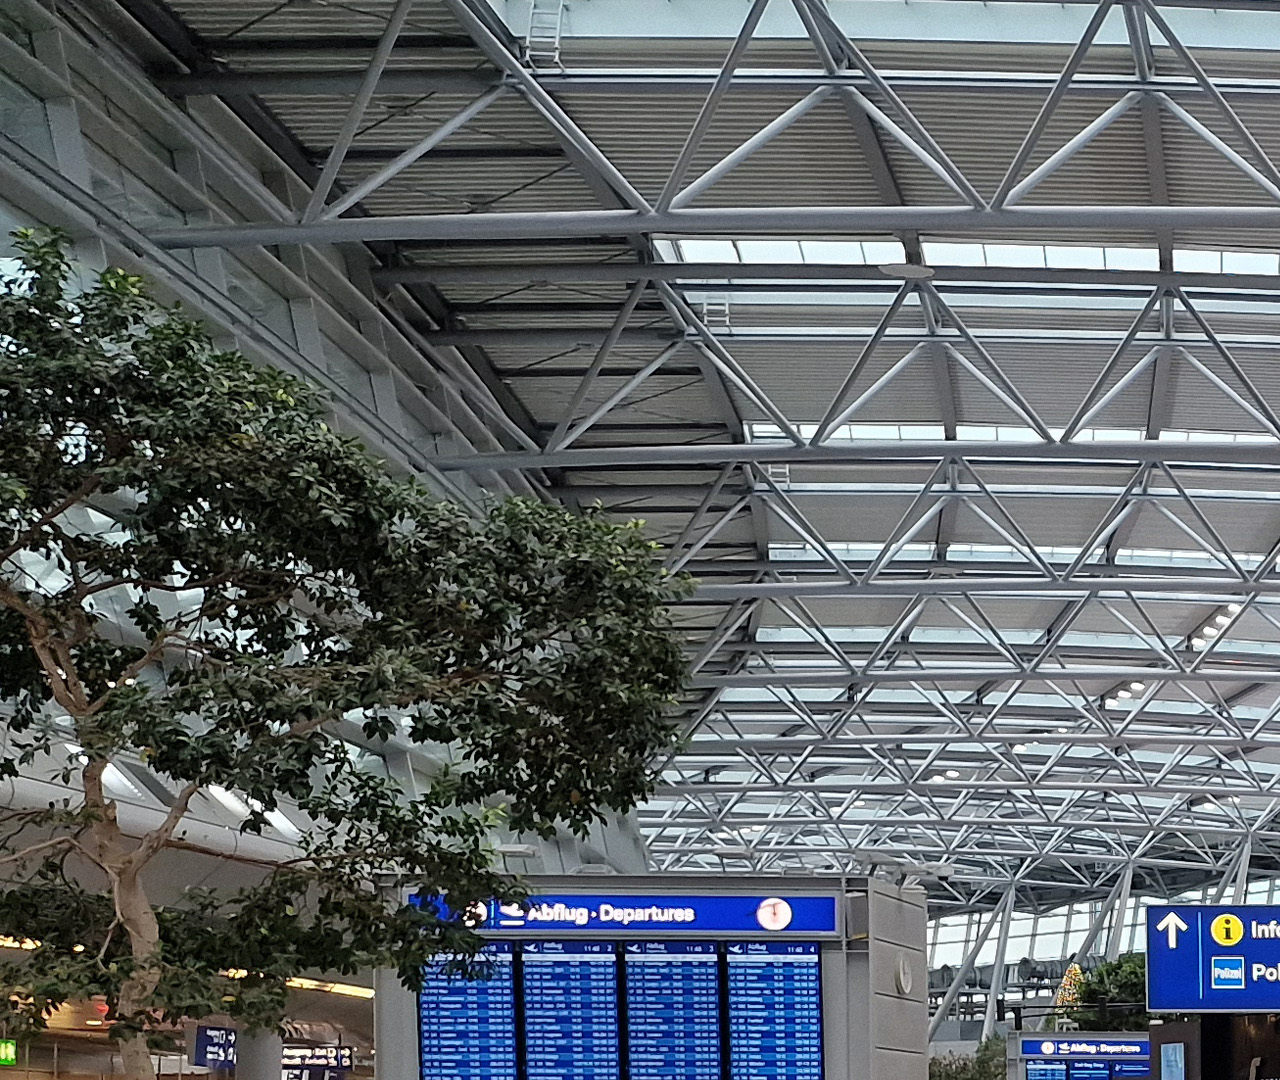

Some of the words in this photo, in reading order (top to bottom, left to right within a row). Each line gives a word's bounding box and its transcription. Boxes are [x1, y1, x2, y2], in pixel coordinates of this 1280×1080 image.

[528, 903, 589, 925] Abflug
[600, 904, 695, 925] Departures
[1215, 966, 1242, 980] Polizei
